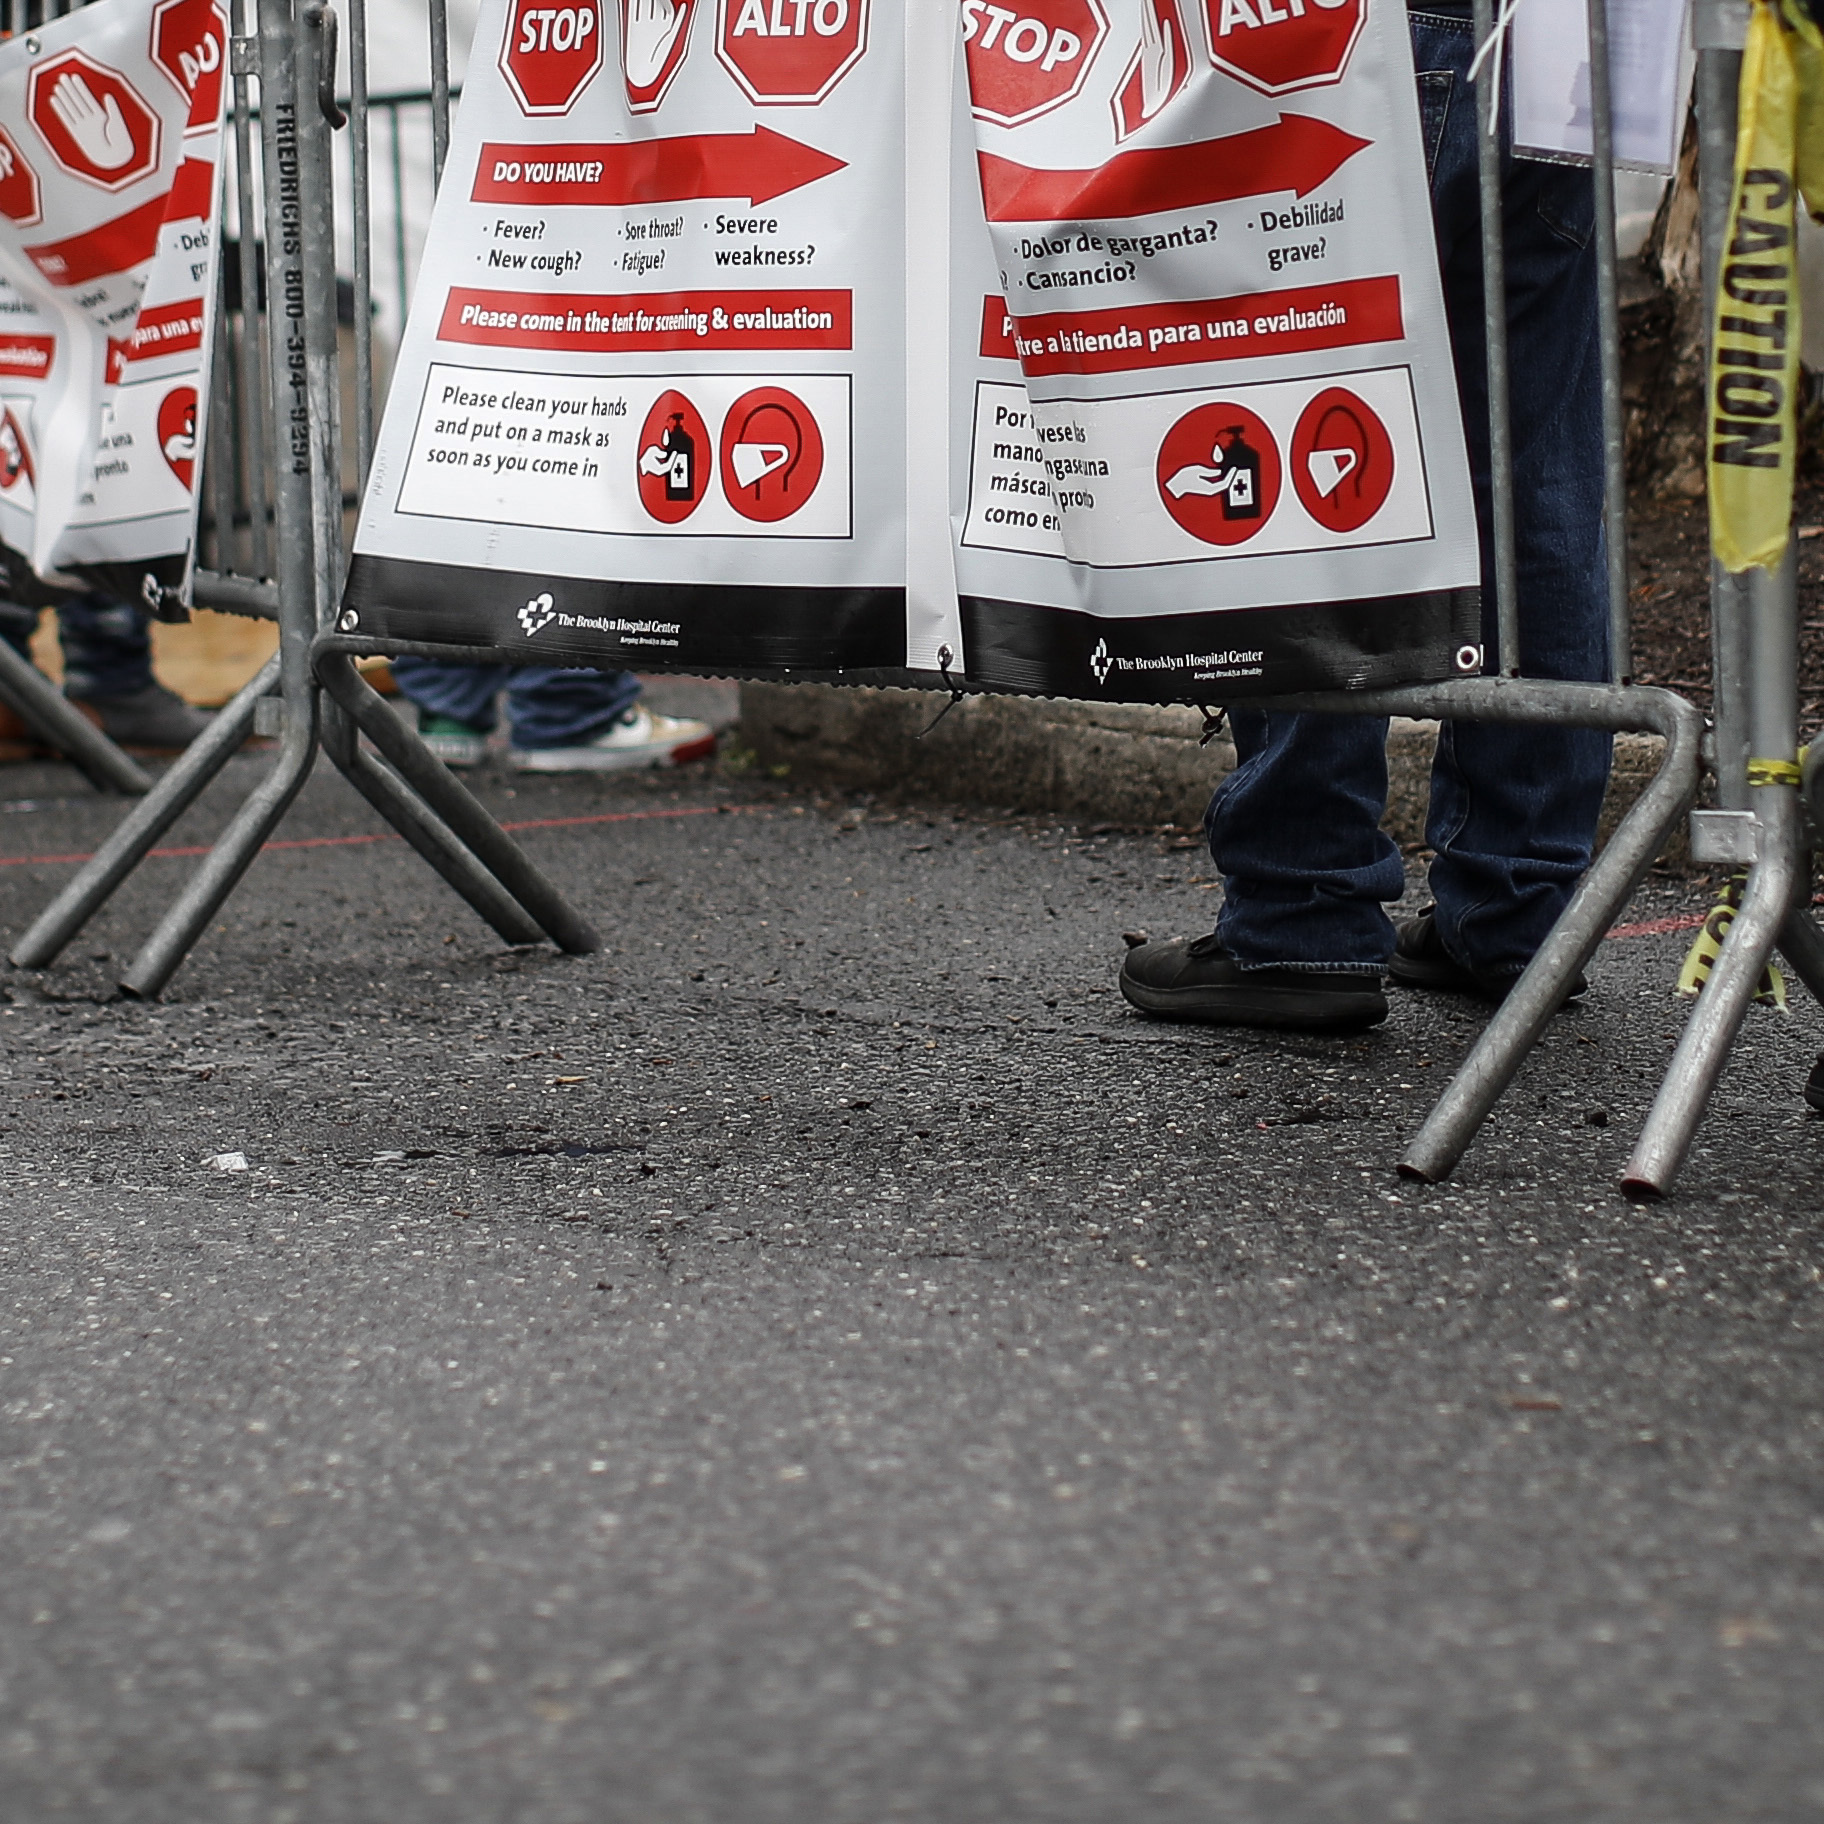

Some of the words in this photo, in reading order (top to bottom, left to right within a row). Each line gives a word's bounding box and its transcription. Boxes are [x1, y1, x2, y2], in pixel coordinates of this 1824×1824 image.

[519, 7, 594, 53] STOP
[276, 103, 302, 255] FRIEDRICHS
[493, 162, 521, 182] DO
[524, 162, 554, 182] YOU
[555, 161, 603, 182] HAVE?
[494, 219, 546, 240] Fever?
[626, 220, 646, 240] Sore
[648, 216, 684, 239] throat?
[716, 215, 778, 235] Severe
[1260, 198, 1344, 233] Debilidad
[1021, 233, 1072, 260] Dolor
[1077, 232, 1103, 253] de
[1107, 220, 1218, 258] garganta?
[1268, 237, 1327, 271] grave?
[488, 249, 527, 270] New
[531, 251, 582, 276] cough?
[621, 249, 665, 276] Fatigue?
[715, 245, 816, 266] weakness?
[1026, 261, 1136, 290] Cansancio?
[164, 320, 189, 338] una
[461, 305, 517, 328] Please
[520, 311, 566, 330] come
[567, 310, 582, 332] in
[584, 310, 610, 332] the
[612, 314, 634, 333] tent
[636, 310, 654, 332] for
[655, 308, 708, 336] screening
[712, 307, 729, 329] &
[733, 308, 832, 330] evaluation
[1047, 336, 1059, 353] a
[1073, 325, 1142, 353] tienda
[1149, 324, 1201, 352] para
[1206, 316, 1249, 339] una
[1254, 302, 1346, 335] evaluación
[1712, 167, 1790, 469] CAUTION
[284, 268, 310, 476] 800-394-9294
[442, 386, 497, 408] Please
[501, 391, 546, 412] clean
[548, 400, 588, 419] your
[591, 396, 627, 417] hands
[995, 406, 1027, 429] Por
[434, 417, 470, 435] and
[470, 422, 502, 442] put
[506, 426, 527, 441] on
[532, 428, 542, 442] a
[547, 427, 592, 446] mask
[595, 432, 610, 448] as
[427, 448, 469, 465] soon
[473, 453, 491, 468] as
[494, 455, 527, 475] you
[532, 458, 578, 476] come
[582, 458, 598, 477] in
[984, 507, 1038, 528] como
[558, 613, 575, 627] The
[577, 615, 615, 632] Brooklyn
[616, 619, 651, 634] Hospital
[651, 620, 680, 634] Center
[1116, 657, 1134, 670] The
[1136, 656, 1184, 671] Brooklyn
[1185, 651, 1227, 668] Hospital
[1228, 650, 1264, 664] Center
